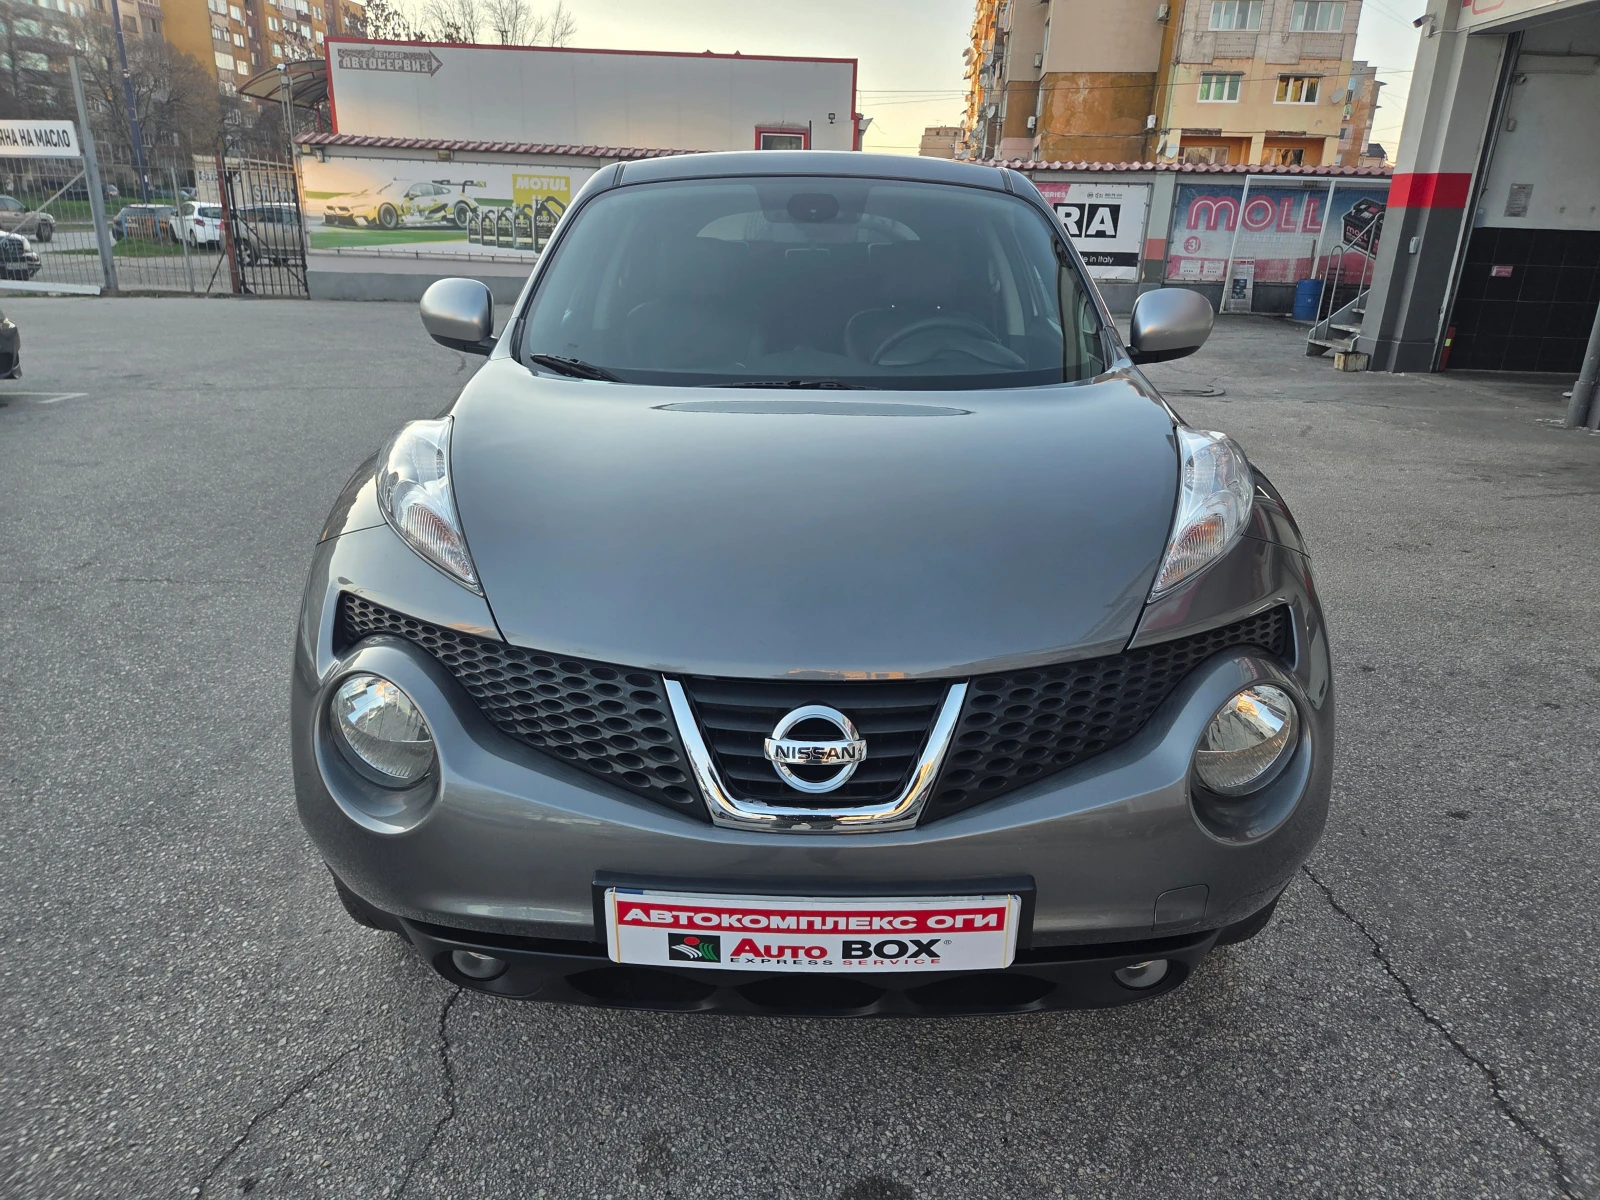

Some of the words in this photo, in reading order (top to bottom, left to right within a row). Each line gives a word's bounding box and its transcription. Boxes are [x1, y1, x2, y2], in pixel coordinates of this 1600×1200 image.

[342, 57, 430, 73] АВТОСЕРВИЗ
[18, 128, 35, 147] НА
[33, 128, 71, 147] МАСЛО
[516, 176, 567, 191] MOTUL
[1089, 255, 1097, 263] in
[1097, 255, 1114, 265] Italy
[775, 745, 856, 760] NISSAN
[623, 908, 917, 930] АВТОКОМПЛЕКС
[926, 913, 998, 929] ОГИ
[730, 957, 833, 966] EXPRESS
[842, 958, 941, 966] SERVICE
